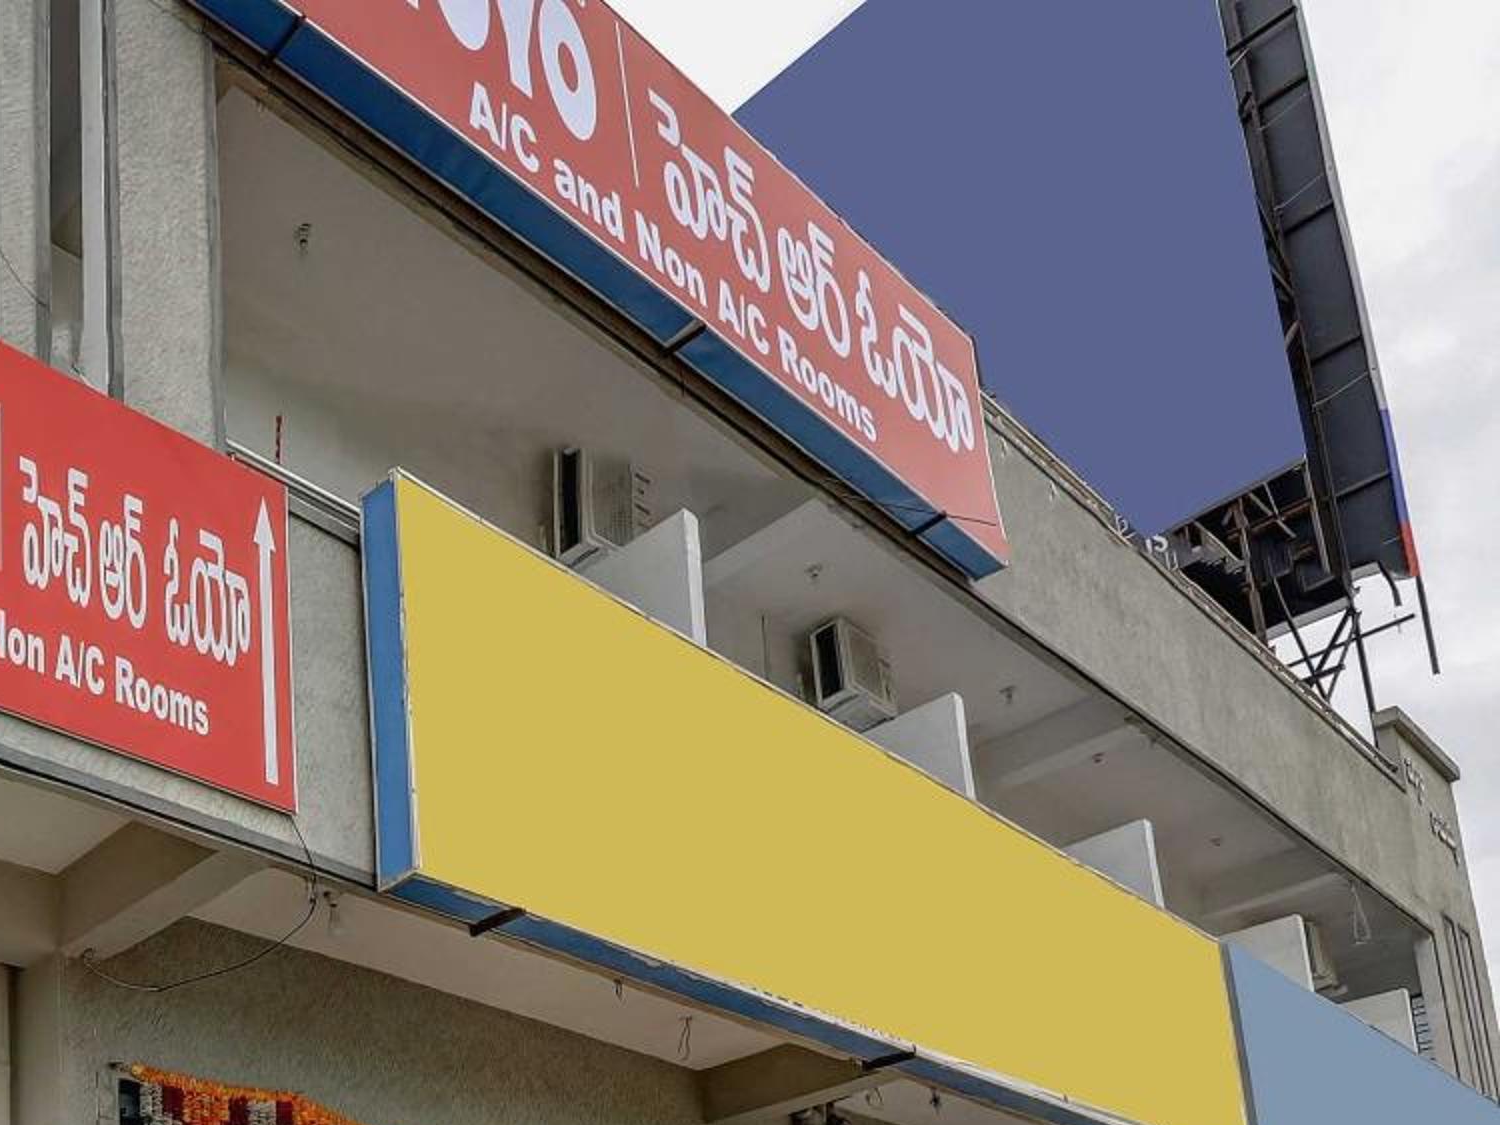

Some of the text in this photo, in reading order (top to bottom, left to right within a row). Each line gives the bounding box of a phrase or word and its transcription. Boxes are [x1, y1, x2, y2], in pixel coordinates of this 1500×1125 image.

[469, 81, 877, 443] A/C and Non A/C Rooms
[55, 633, 105, 696] A/C
[115, 655, 209, 737] Rooms
